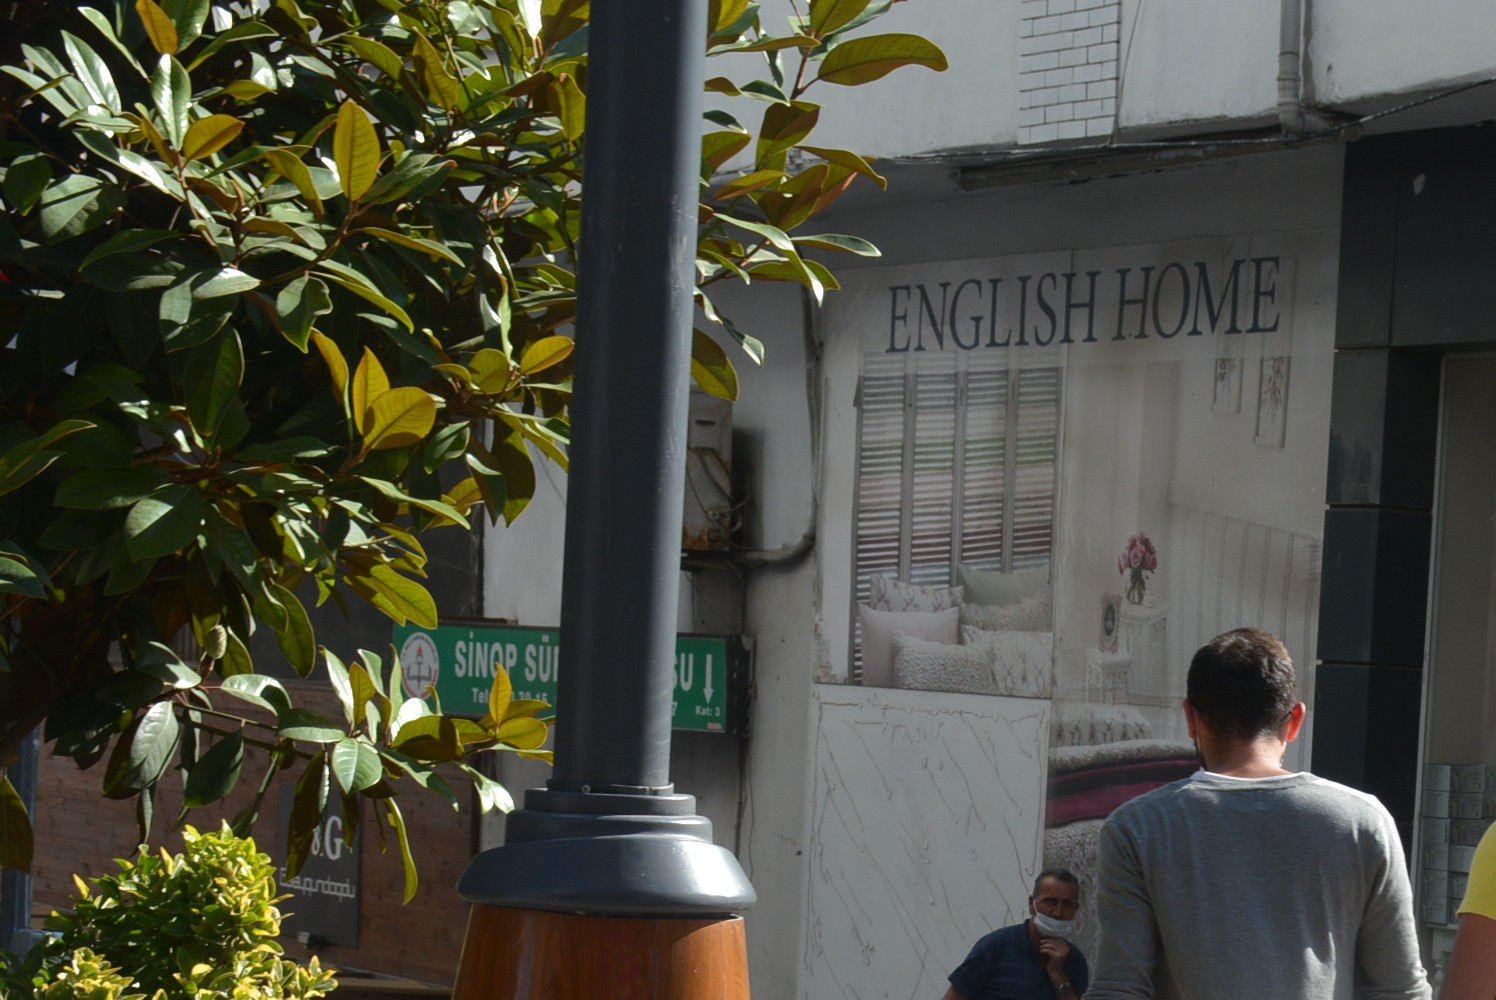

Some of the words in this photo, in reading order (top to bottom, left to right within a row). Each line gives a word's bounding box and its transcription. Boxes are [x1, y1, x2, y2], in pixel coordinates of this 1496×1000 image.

[886, 270, 1100, 353] ENGLISH
[1111, 256, 1281, 341] HOME
[454, 631, 518, 679] SİNOP
